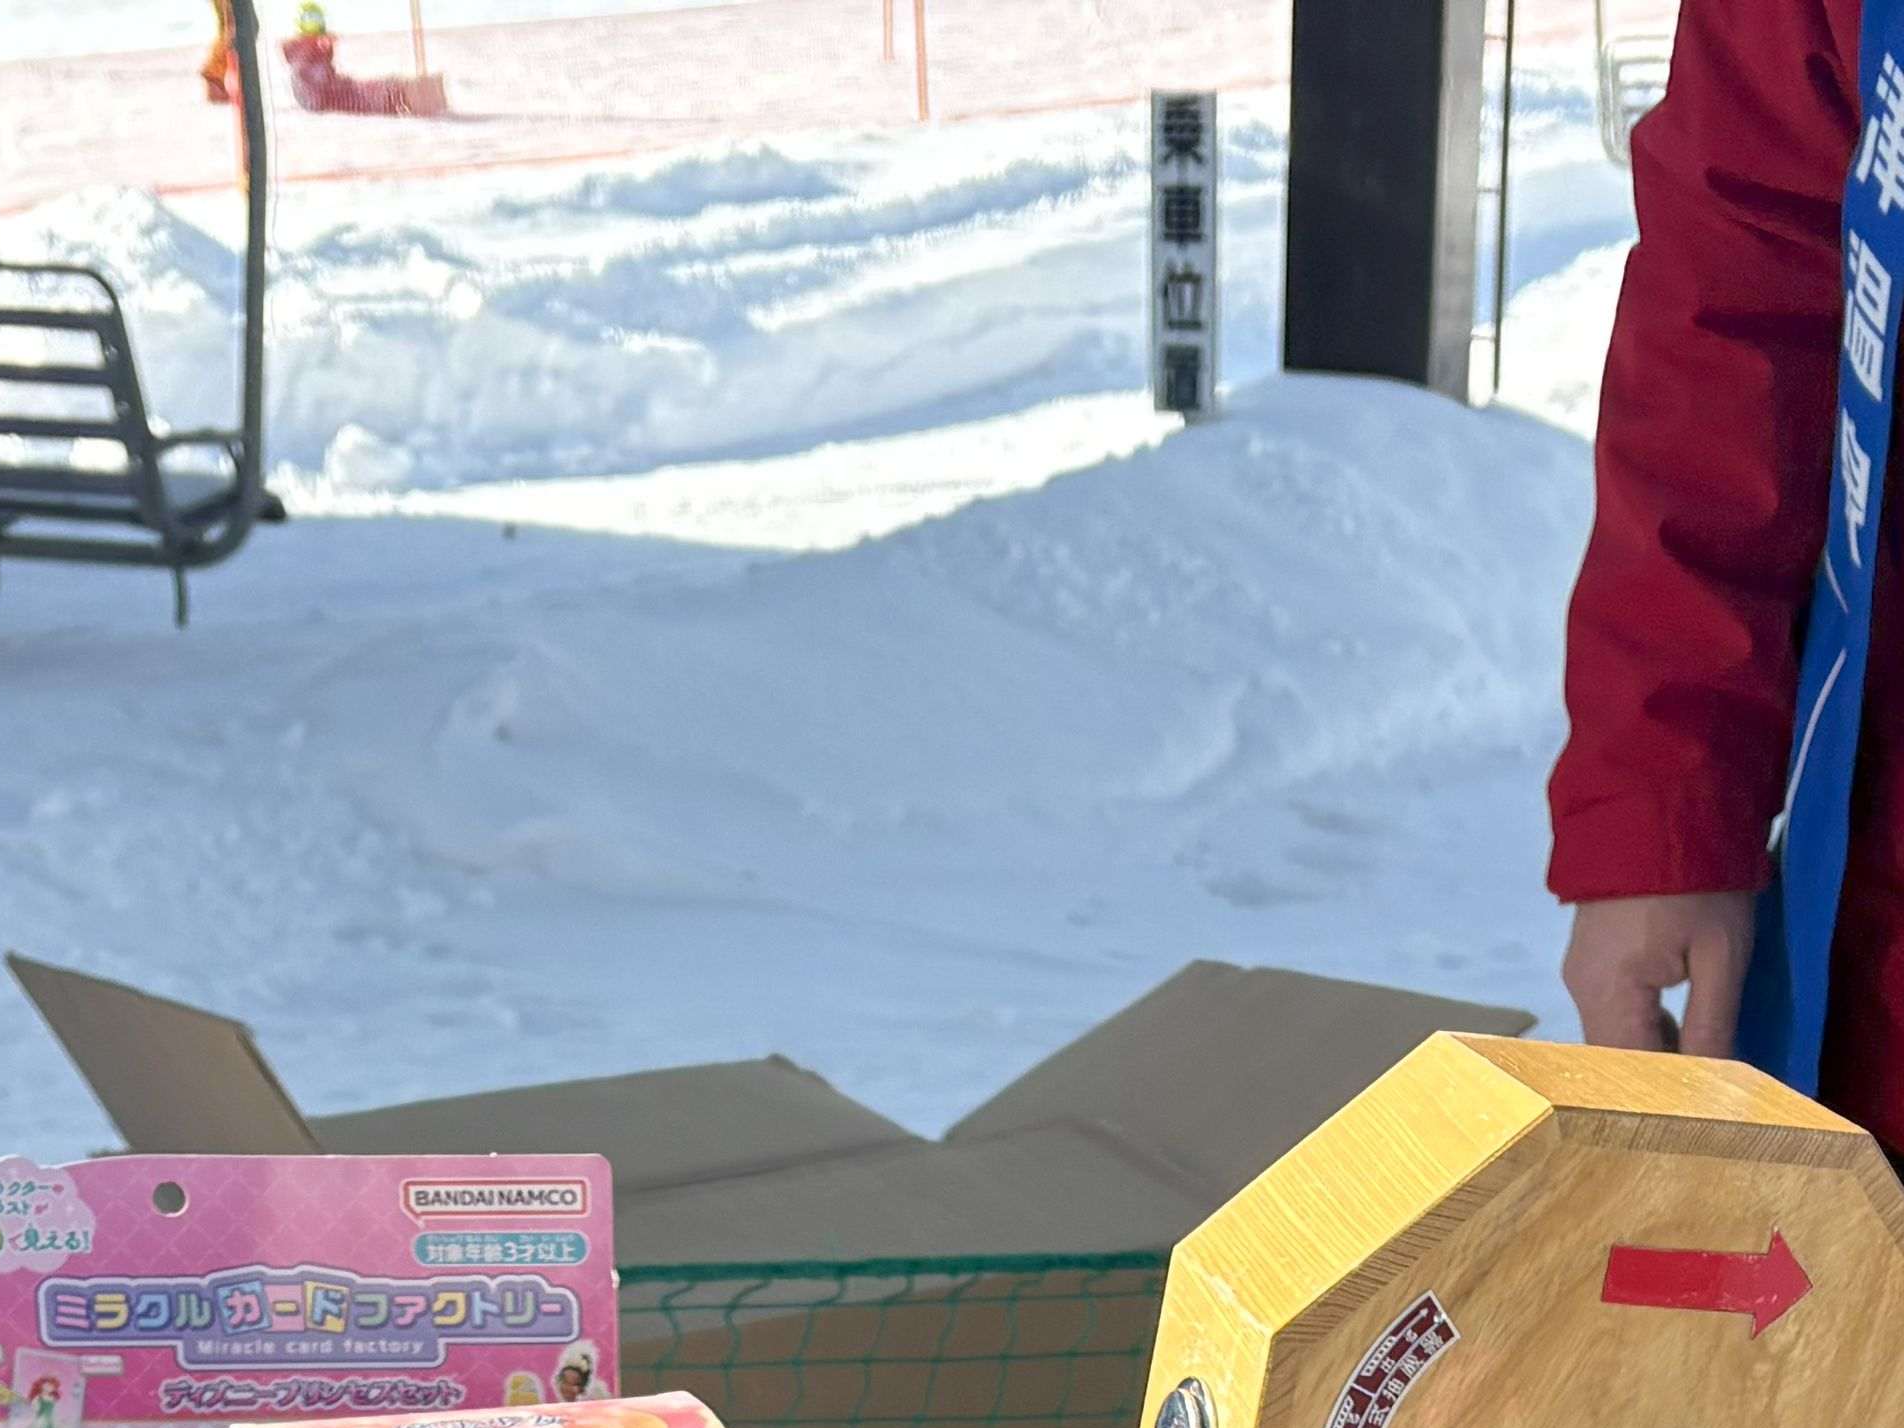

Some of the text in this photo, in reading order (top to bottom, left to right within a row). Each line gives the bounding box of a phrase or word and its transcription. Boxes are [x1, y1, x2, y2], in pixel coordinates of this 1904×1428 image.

[414, 1188, 578, 1208] BANDAI NAMCO
[53, 1281, 563, 1335] ミラクルカードファクトリー
[195, 1338, 425, 1357] Miracle card factory
[160, 1377, 465, 1412] ディズニープリンセスセット
